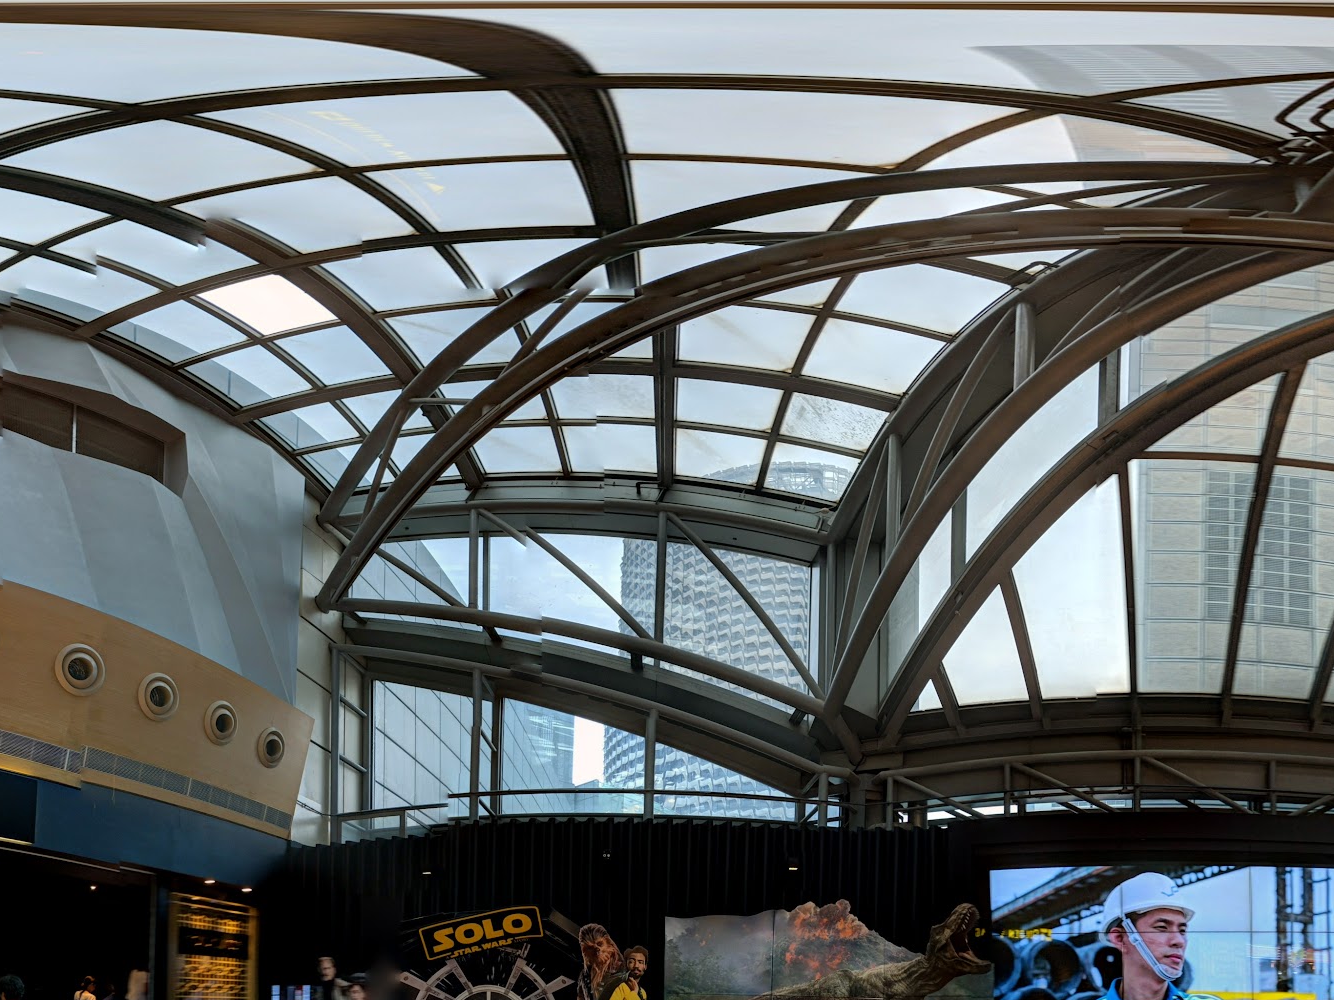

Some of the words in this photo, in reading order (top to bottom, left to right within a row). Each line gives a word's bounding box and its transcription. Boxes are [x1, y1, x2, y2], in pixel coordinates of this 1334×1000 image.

[433, 913, 533, 953] SOLO
[450, 945, 483, 958] STAR
[482, 938, 514, 950] WARS
